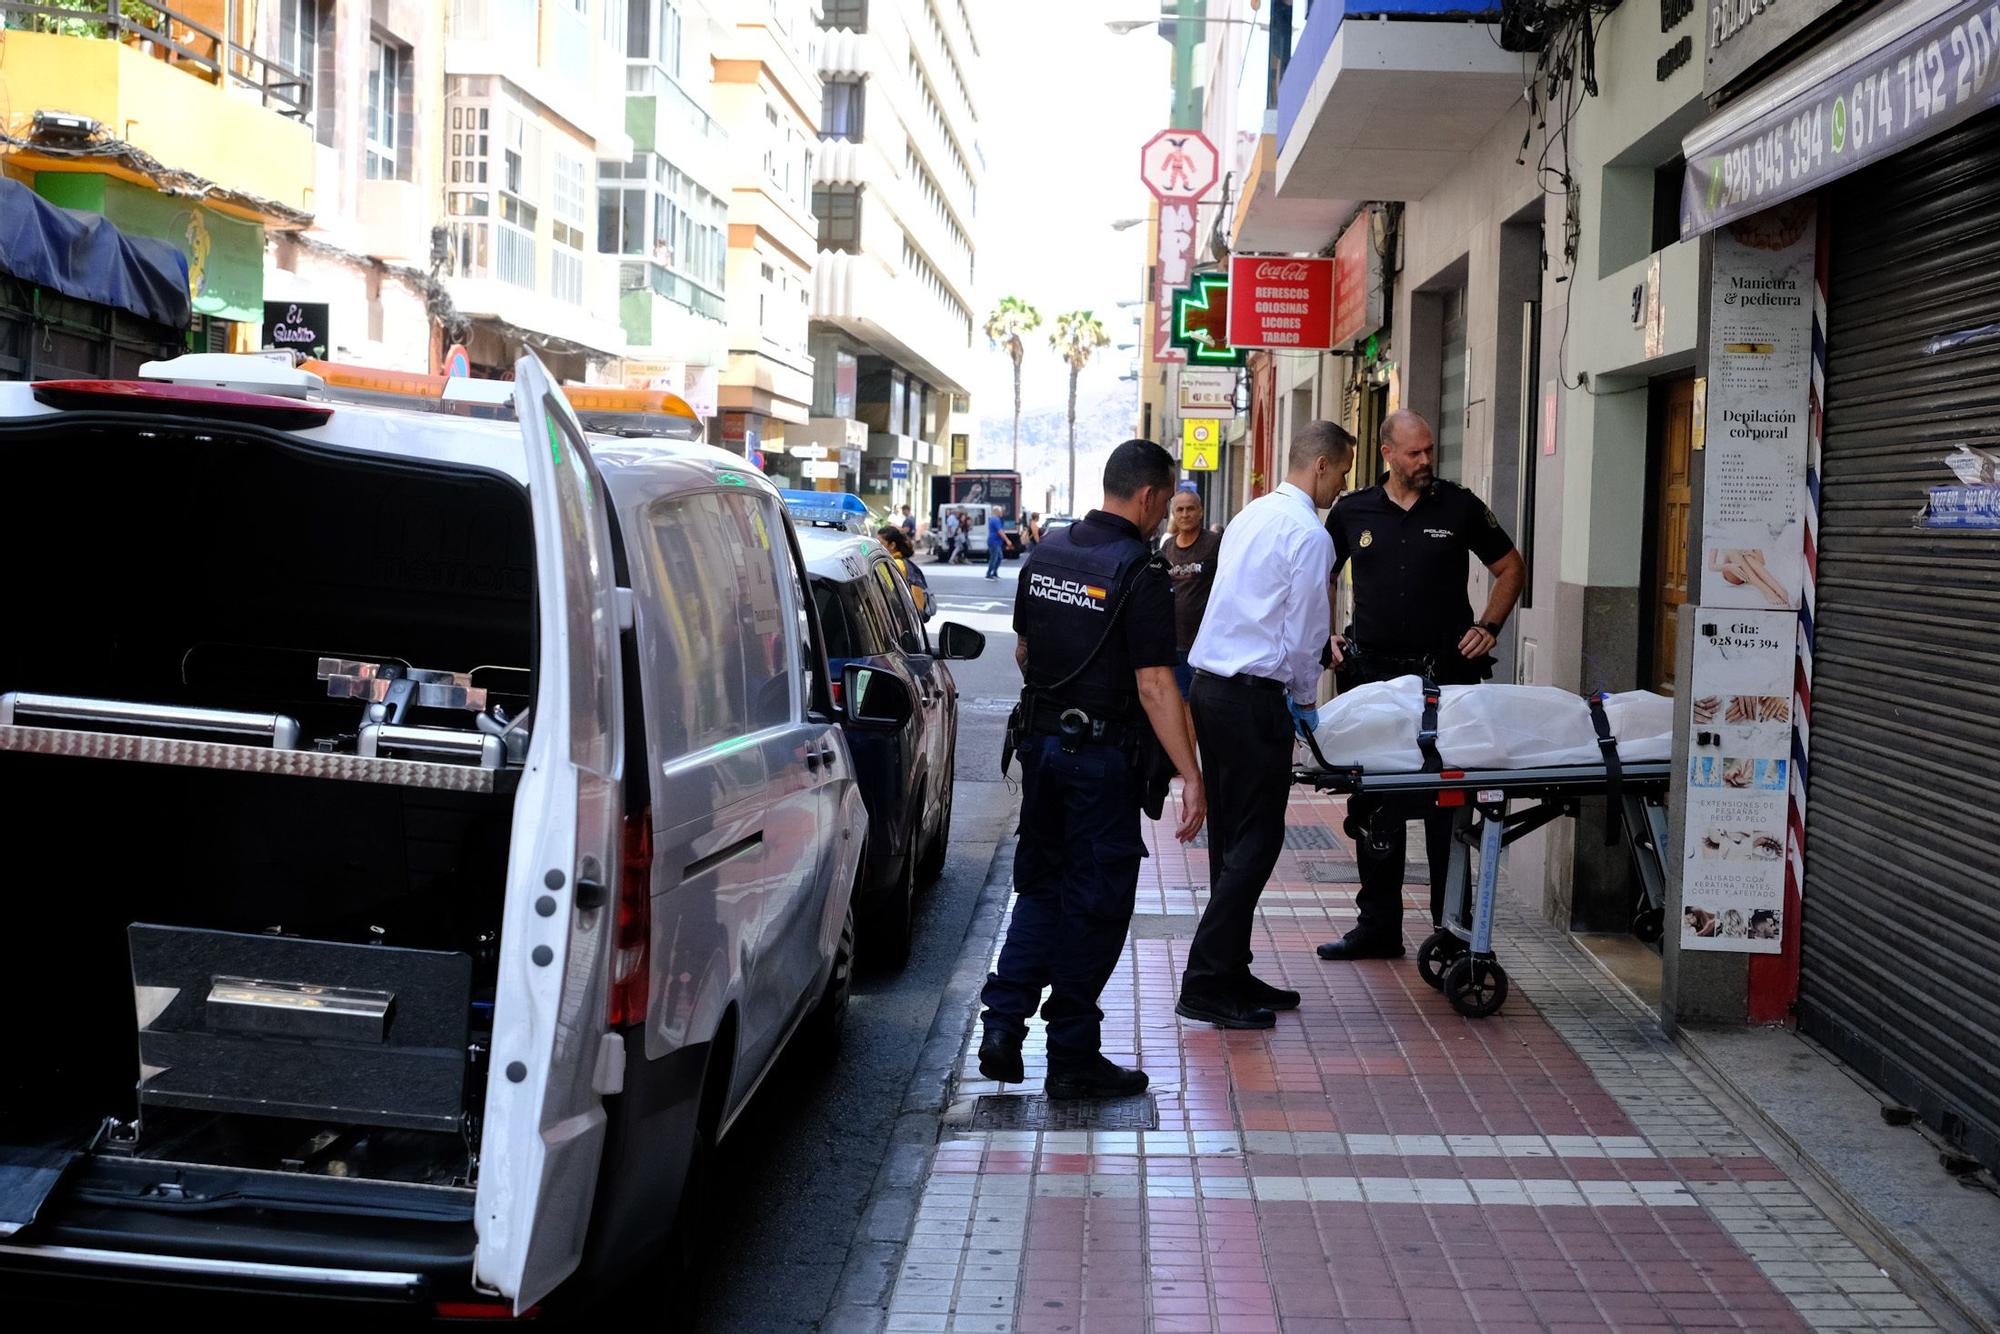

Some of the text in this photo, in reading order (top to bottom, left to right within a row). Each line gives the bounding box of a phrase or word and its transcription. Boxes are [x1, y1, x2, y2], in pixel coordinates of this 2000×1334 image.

[1722, 148, 1750, 208] 928
[1755, 126, 1784, 195] 945
[1790, 103, 1822, 180] 394
[1851, 70, 1892, 150] 674
[1898, 40, 1946, 128] 742
[1731, 277, 1796, 290] Manicura
[1256, 287, 1310, 299] REFRESCOS
[1724, 292, 1800, 307] & pedicura
[1256, 302, 1308, 314] GOLOSINAS
[1262, 316, 1301, 328] LICORES
[1262, 332, 1300, 344] TABACO
[1724, 410, 1796, 424] Depilación
[1730, 426, 1788, 440] corporal
[1030, 573, 1088, 596] POLICIA
[1029, 584, 1104, 612] NACIONAL
[1731, 623, 1758, 634] Cita:
[1710, 636, 1778, 649] 928 945 394
[1700, 800, 1760, 808] EXTENSIONES
